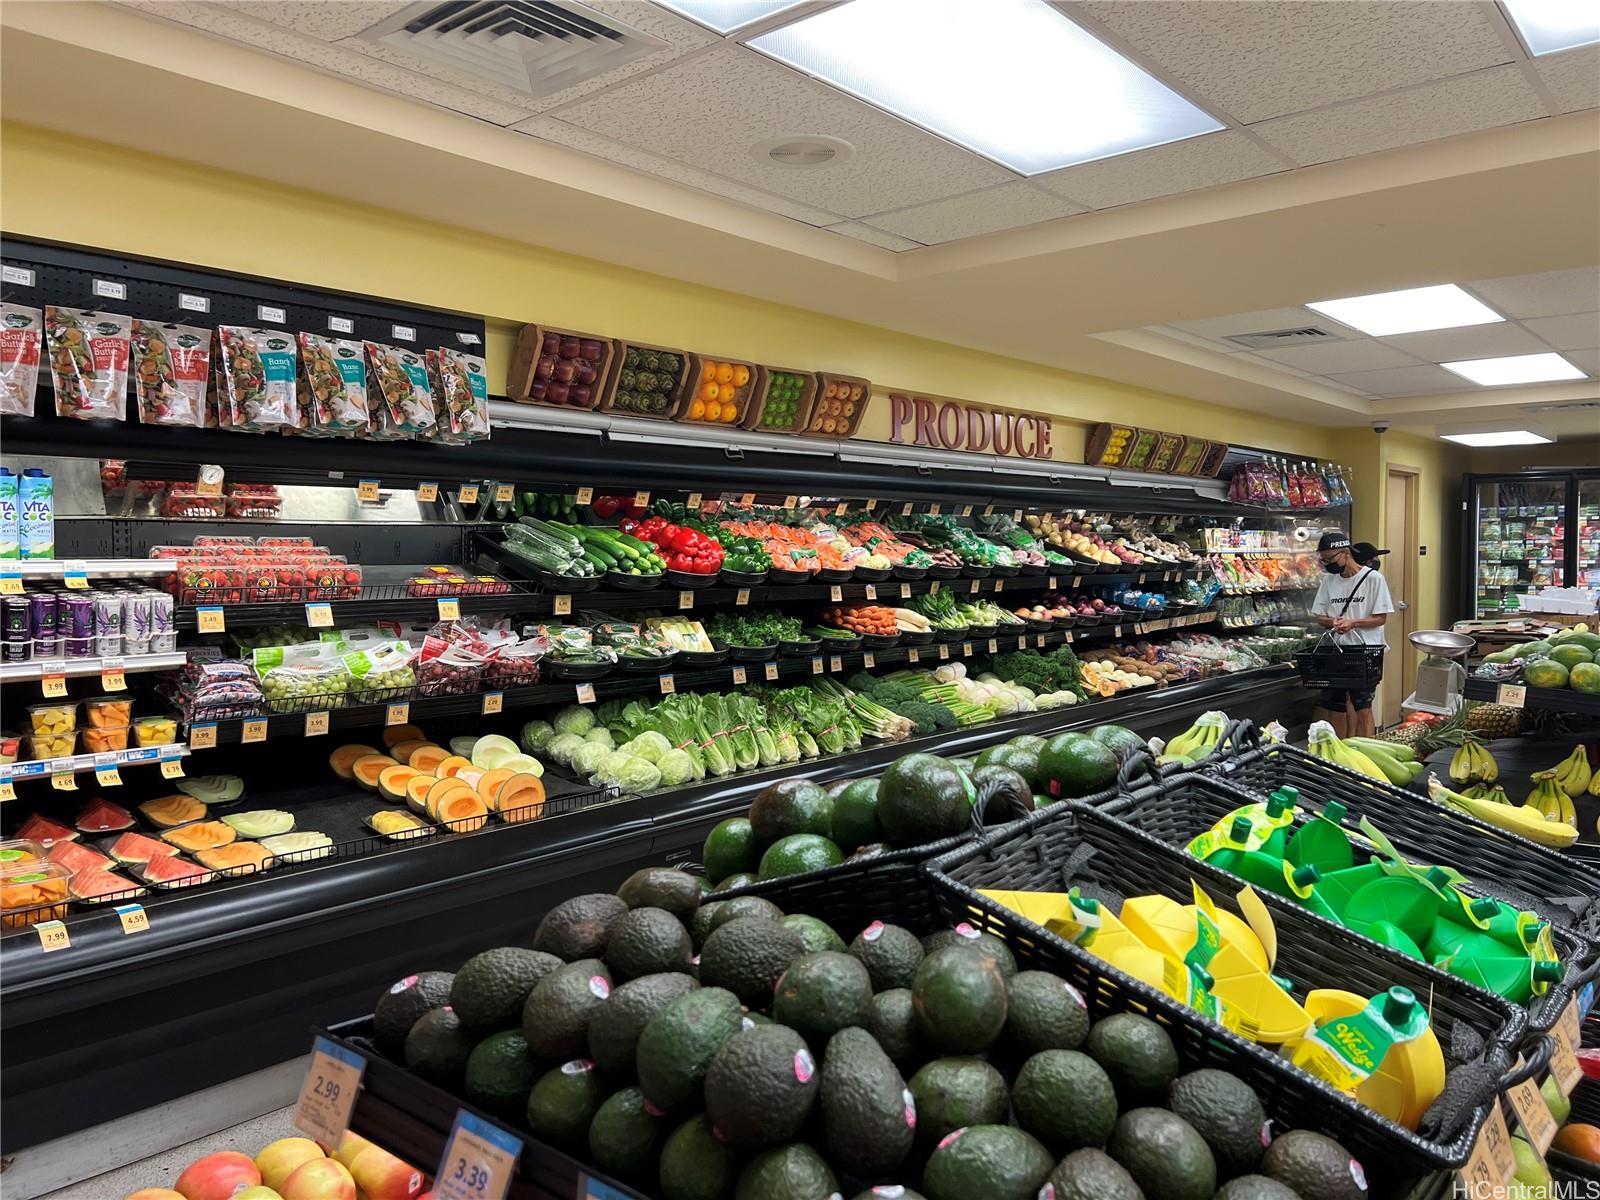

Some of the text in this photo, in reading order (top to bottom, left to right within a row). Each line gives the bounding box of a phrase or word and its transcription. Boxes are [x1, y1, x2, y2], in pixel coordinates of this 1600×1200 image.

[888, 394, 1053, 459] PRODUCE
[24, 501, 50, 512] VITA
[48, 682, 64, 692] 3.99
[107, 678, 123, 686] 3.99
[128, 751, 144, 760] WIC
[11, 765, 28, 775] WIC
[166, 766, 180, 774] 6.39
[57, 779, 73, 787] 4.69
[103, 773, 118, 782] 4.99
[127, 914, 144, 925] 4.59
[47, 931, 65, 942] 7.99
[1335, 1022, 1374, 1069] Wedge
[313, 1075, 340, 1102] 2.99
[1521, 1085, 1534, 1114] 2.69
[454, 1157, 488, 1192] 3.39
